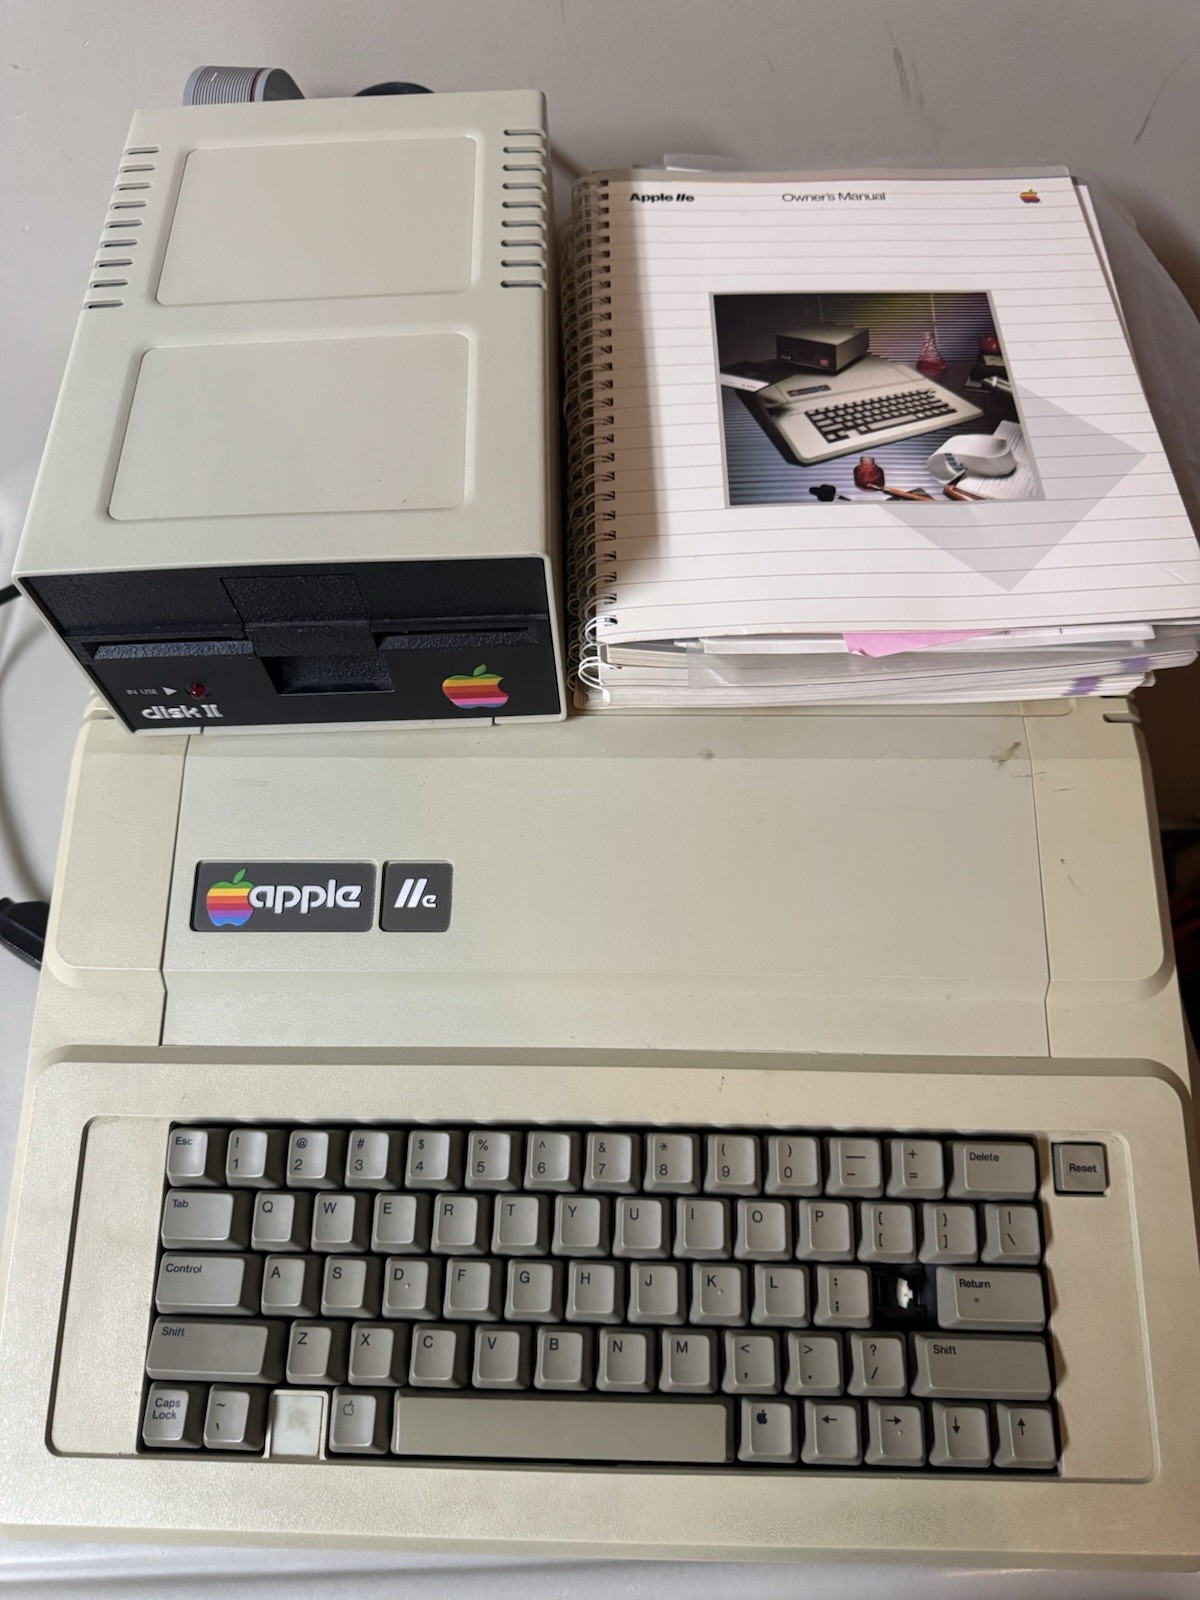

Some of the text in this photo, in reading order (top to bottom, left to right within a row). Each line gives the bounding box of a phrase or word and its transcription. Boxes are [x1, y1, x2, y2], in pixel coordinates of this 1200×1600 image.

[629, 192, 673, 204] Apple
[781, 191, 886, 202] Owner's Manual
[142, 704, 202, 720] disk
[249, 878, 363, 914] apple
[174, 1136, 194, 1146] Esc
[235, 1136, 240, 1148] !
[295, 1137, 308, 1149] @
[357, 1138, 365, 1150] #
[418, 1138, 425, 1150] $
[477, 1139, 489, 1151] %
[598, 1141, 606, 1153] &
[721, 1143, 726, 1157] (
[787, 1144, 792, 1158] )
[908, 1149, 917, 1159] +
[969, 1152, 1000, 1162] Delete
[233, 1158, 239, 1170] 1
[293, 1158, 303, 1171] 2
[354, 1158, 364, 1171] 3
[415, 1160, 424, 1172] 4
[476, 1161, 485, 1173] 5
[537, 1161, 546, 1174] 6
[598, 1163, 607, 1176] 7
[659, 1163, 668, 1177] 8
[1068, 1163, 1097, 1173] Reset
[721, 1165, 730, 1178] 9
[783, 1166, 793, 1179] 0
[172, 1199, 189, 1209] Tab
[261, 1200, 274, 1214] Q
[323, 1201, 337, 1214] W
[383, 1202, 392, 1215] E
[443, 1203, 454, 1216] R
[506, 1203, 516, 1217] T
[567, 1205, 578, 1218] Y
[629, 1207, 640, 1221] U
[751, 1210, 763, 1223] O
[815, 1209, 824, 1223] P
[877, 1211, 883, 1226] {
[942, 1213, 948, 1228] }
[878, 1232, 884, 1247] [
[942, 1234, 948, 1249] ]
[165, 1263, 202, 1274] Control
[270, 1265, 281, 1279] A
[332, 1266, 342, 1280] S
[393, 1268, 404, 1281] D
[457, 1268, 467, 1282] F
[519, 1270, 530, 1284] G
[580, 1271, 591, 1285] H
[644, 1273, 653, 1287] J
[707, 1274, 716, 1288] K
[770, 1275, 779, 1289] L
[833, 1277, 838, 1287] :
[958, 1279, 991, 1289] Return
[835, 1301, 839, 1312] ;
[161, 1327, 185, 1337] Shift
[297, 1331, 308, 1345] Z
[360, 1333, 371, 1346] X
[422, 1335, 434, 1349] C
[487, 1336, 497, 1350] V
[549, 1337, 559, 1351] B
[612, 1339, 623, 1353] N
[676, 1340, 688, 1354] M
[740, 1343, 750, 1354] <
[803, 1344, 814, 1355] >
[869, 1343, 877, 1358] ?
[932, 1345, 957, 1355] Shift
[870, 1366, 879, 1380] /
[153, 1398, 181, 1411] Caps
[151, 1410, 176, 1420] Lock
